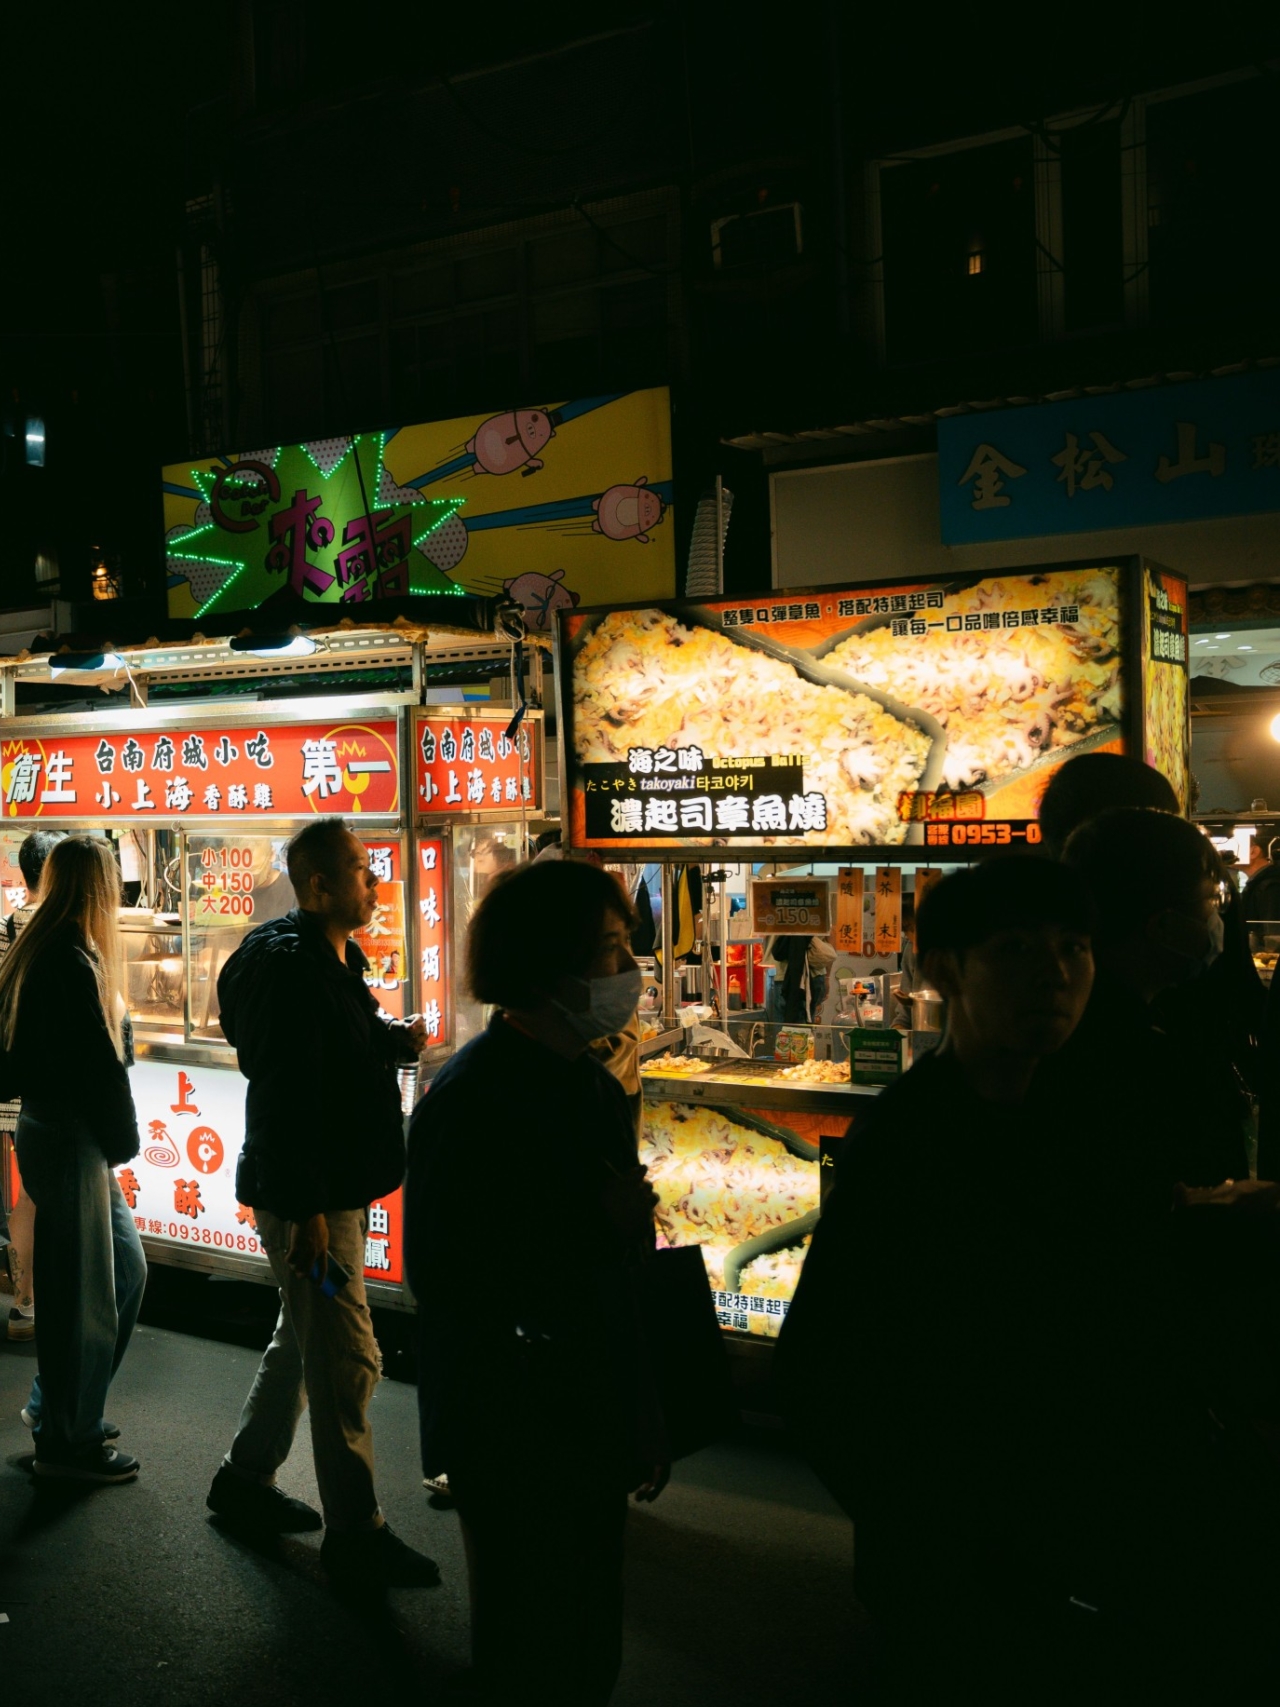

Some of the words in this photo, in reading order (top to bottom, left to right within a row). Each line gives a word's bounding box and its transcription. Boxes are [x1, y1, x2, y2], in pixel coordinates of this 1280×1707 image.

[94, 732, 276, 775] 台南府城小吃
[299, 739, 392, 799] 第一
[628, 745, 704, 774] 海之味
[4, 750, 78, 804] 衛生
[94, 776, 193, 812] 小上海
[203, 784, 275, 811] 香酥雞
[419, 767, 487, 804] 小上海
[586, 777, 638, 793] たこやき
[639, 774, 696, 793] takoyaki
[696, 773, 754, 792] 타코야키
[610, 793, 827, 834] 濃起司章魚燒
[201, 849, 216, 868] 小
[220, 847, 254, 870] 100
[202, 873, 216, 891] 中
[220, 872, 254, 894] 150
[202, 897, 217, 915] 大
[220, 895, 254, 916] 200
[170, 1071, 202, 1117] 上
